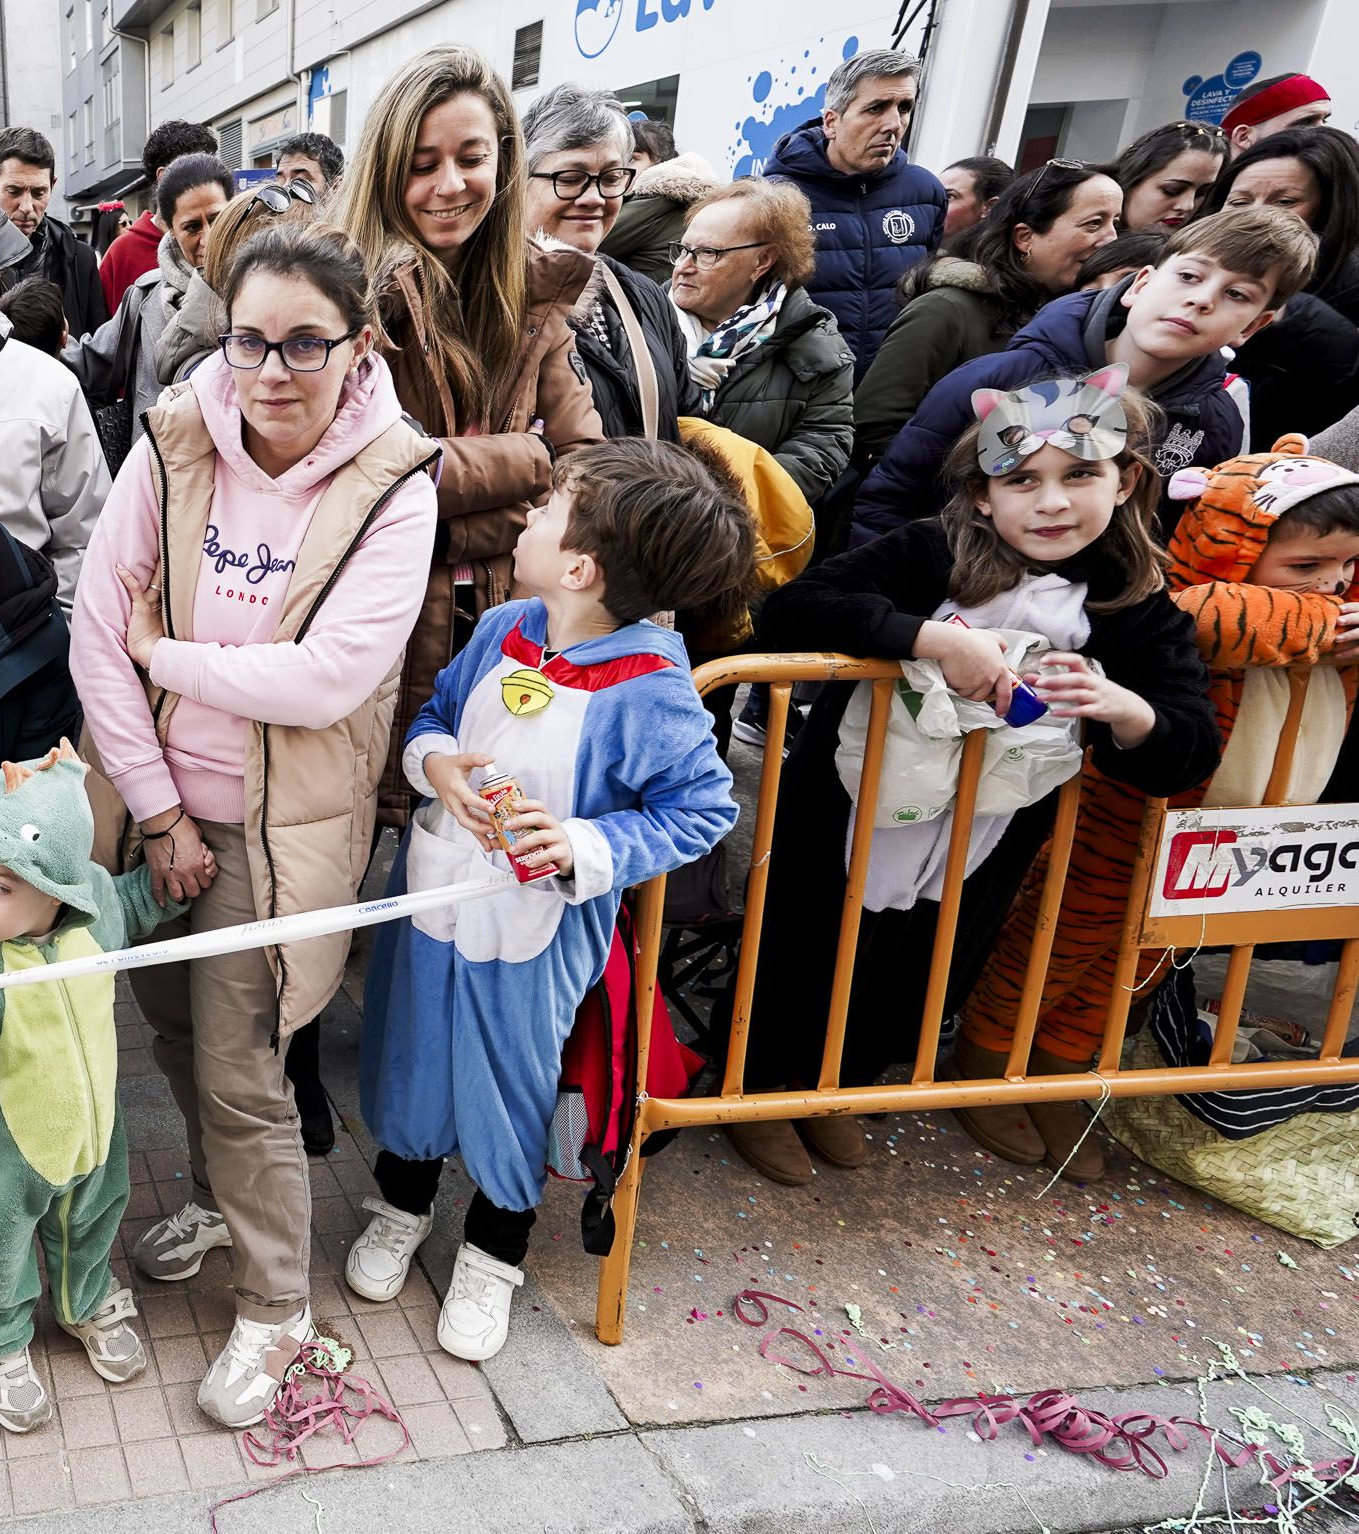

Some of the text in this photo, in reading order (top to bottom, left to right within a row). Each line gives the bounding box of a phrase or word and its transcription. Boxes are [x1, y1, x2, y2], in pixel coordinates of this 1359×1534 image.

[816, 222, 836, 231] CALO
[203, 524, 296, 584] Pepe Jean
[215, 585, 269, 605] LONDO
[1254, 883, 1346, 897] ALQUILER
